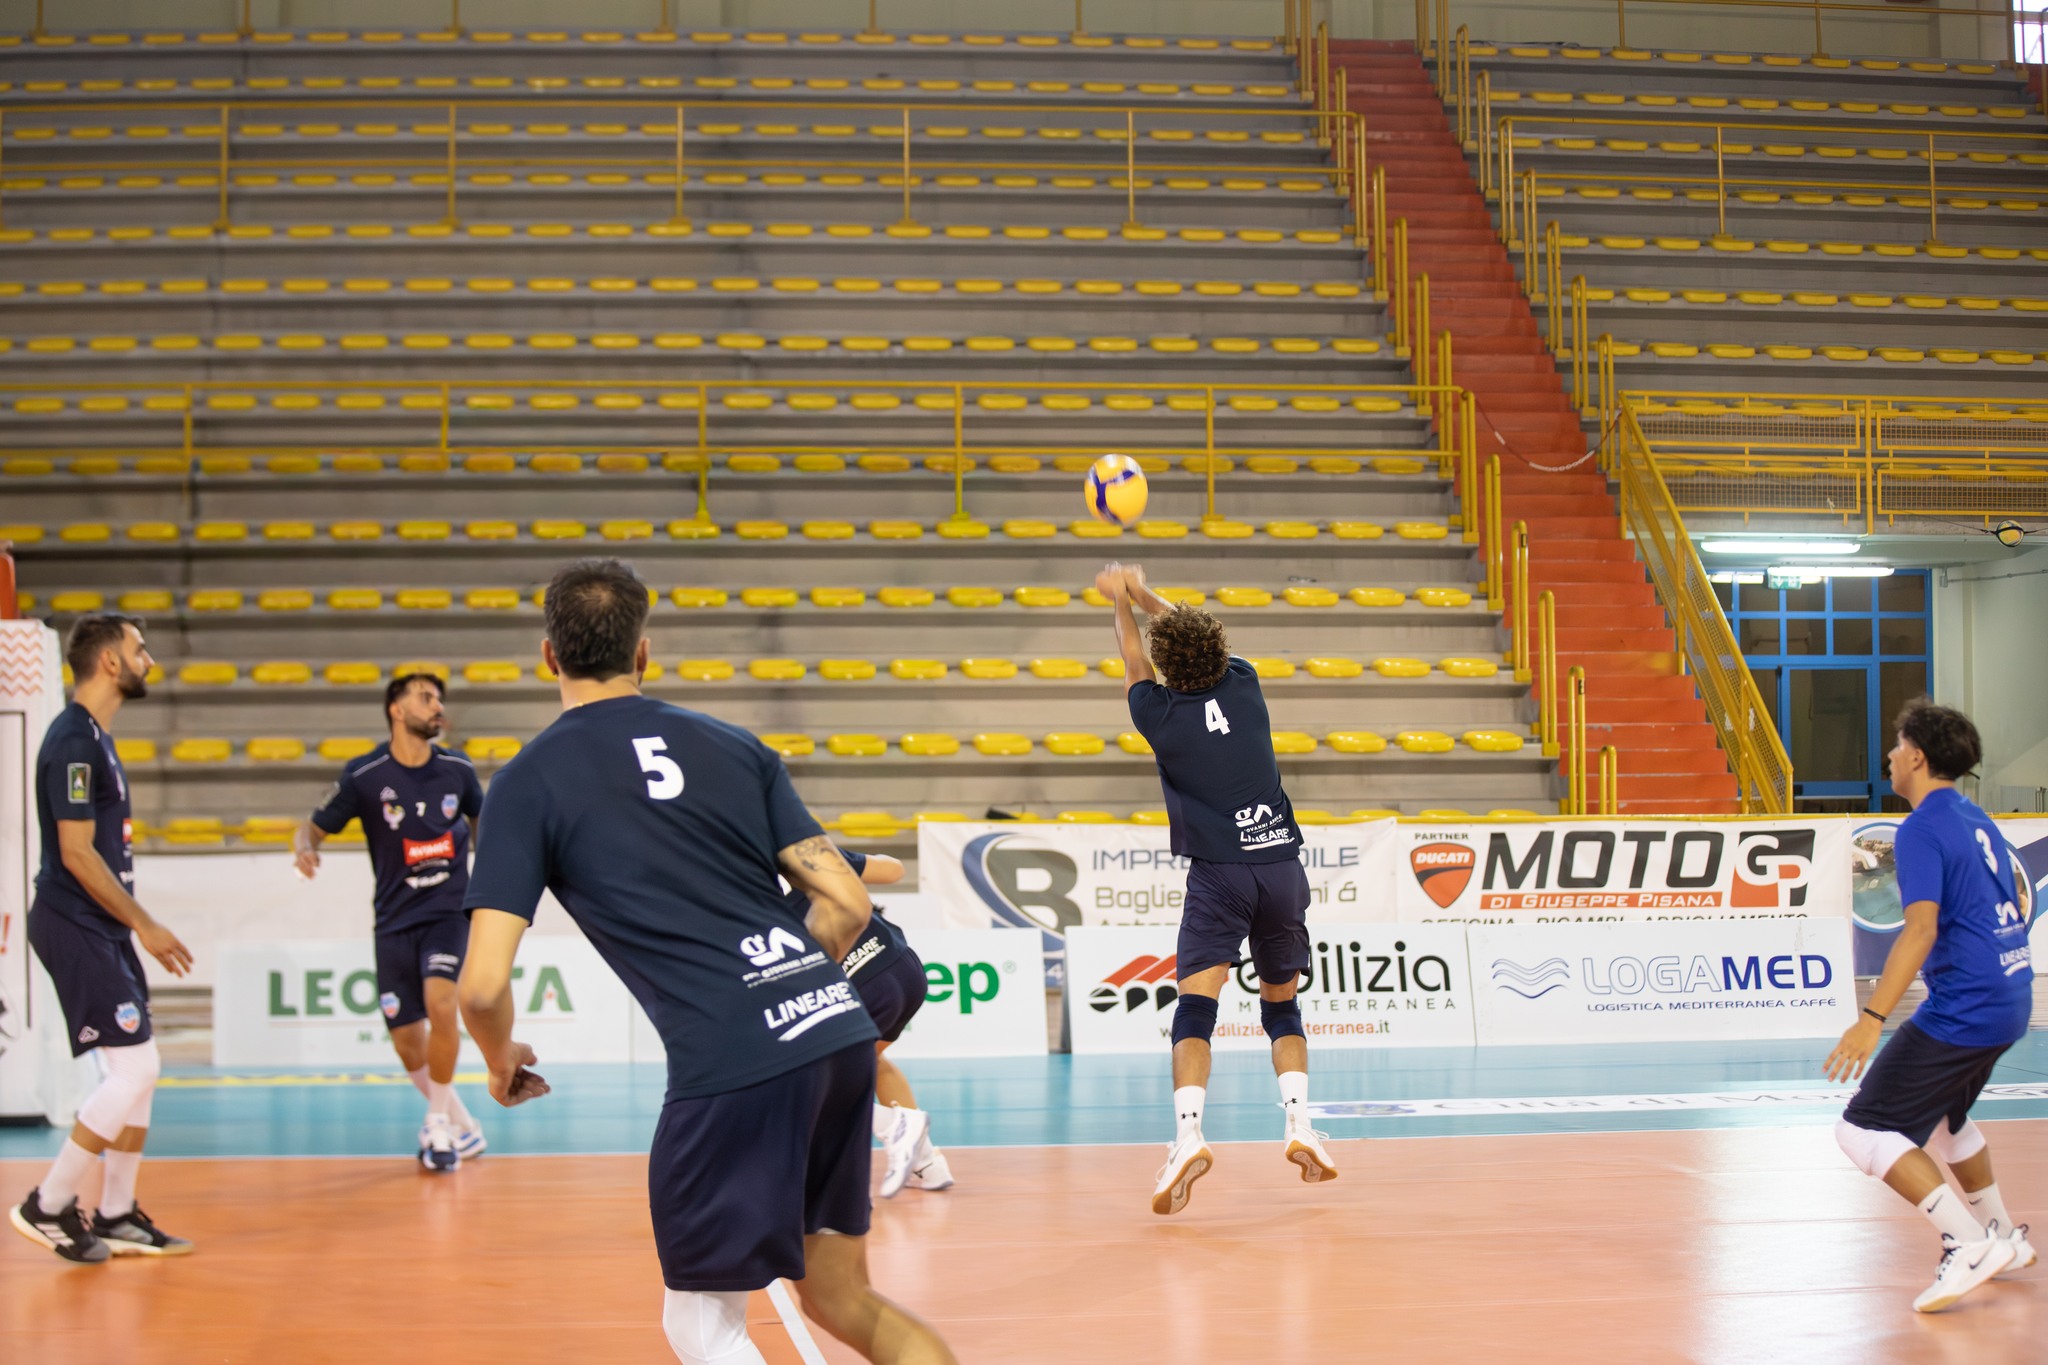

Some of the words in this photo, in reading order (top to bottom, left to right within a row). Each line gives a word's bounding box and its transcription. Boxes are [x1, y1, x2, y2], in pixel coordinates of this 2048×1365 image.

[1204, 698, 1231, 735] 4
[632, 736, 685, 800] 5
[1414, 832, 1469, 841] PARTNER
[1975, 828, 1998, 875] 3
[1092, 848, 1191, 871] IMPR
[1415, 851, 1470, 865] DUCATI
[1481, 830, 1724, 890] MOTO
[1734, 833, 1813, 908] GP
[1095, 881, 1183, 914] Baglie
[1490, 896, 1510, 909] DI
[842, 937, 880, 973] INEARE
[1236, 940, 1452, 995] eilizia
[1582, 955, 1833, 996] LOGAMED
[764, 981, 852, 1030] LINEARE
[1239, 997, 1457, 1013] MITERRANEA
[1587, 1000, 1663, 1012] LOGISTICA
[1669, 999, 1785, 1011] MEDITERRANEA
